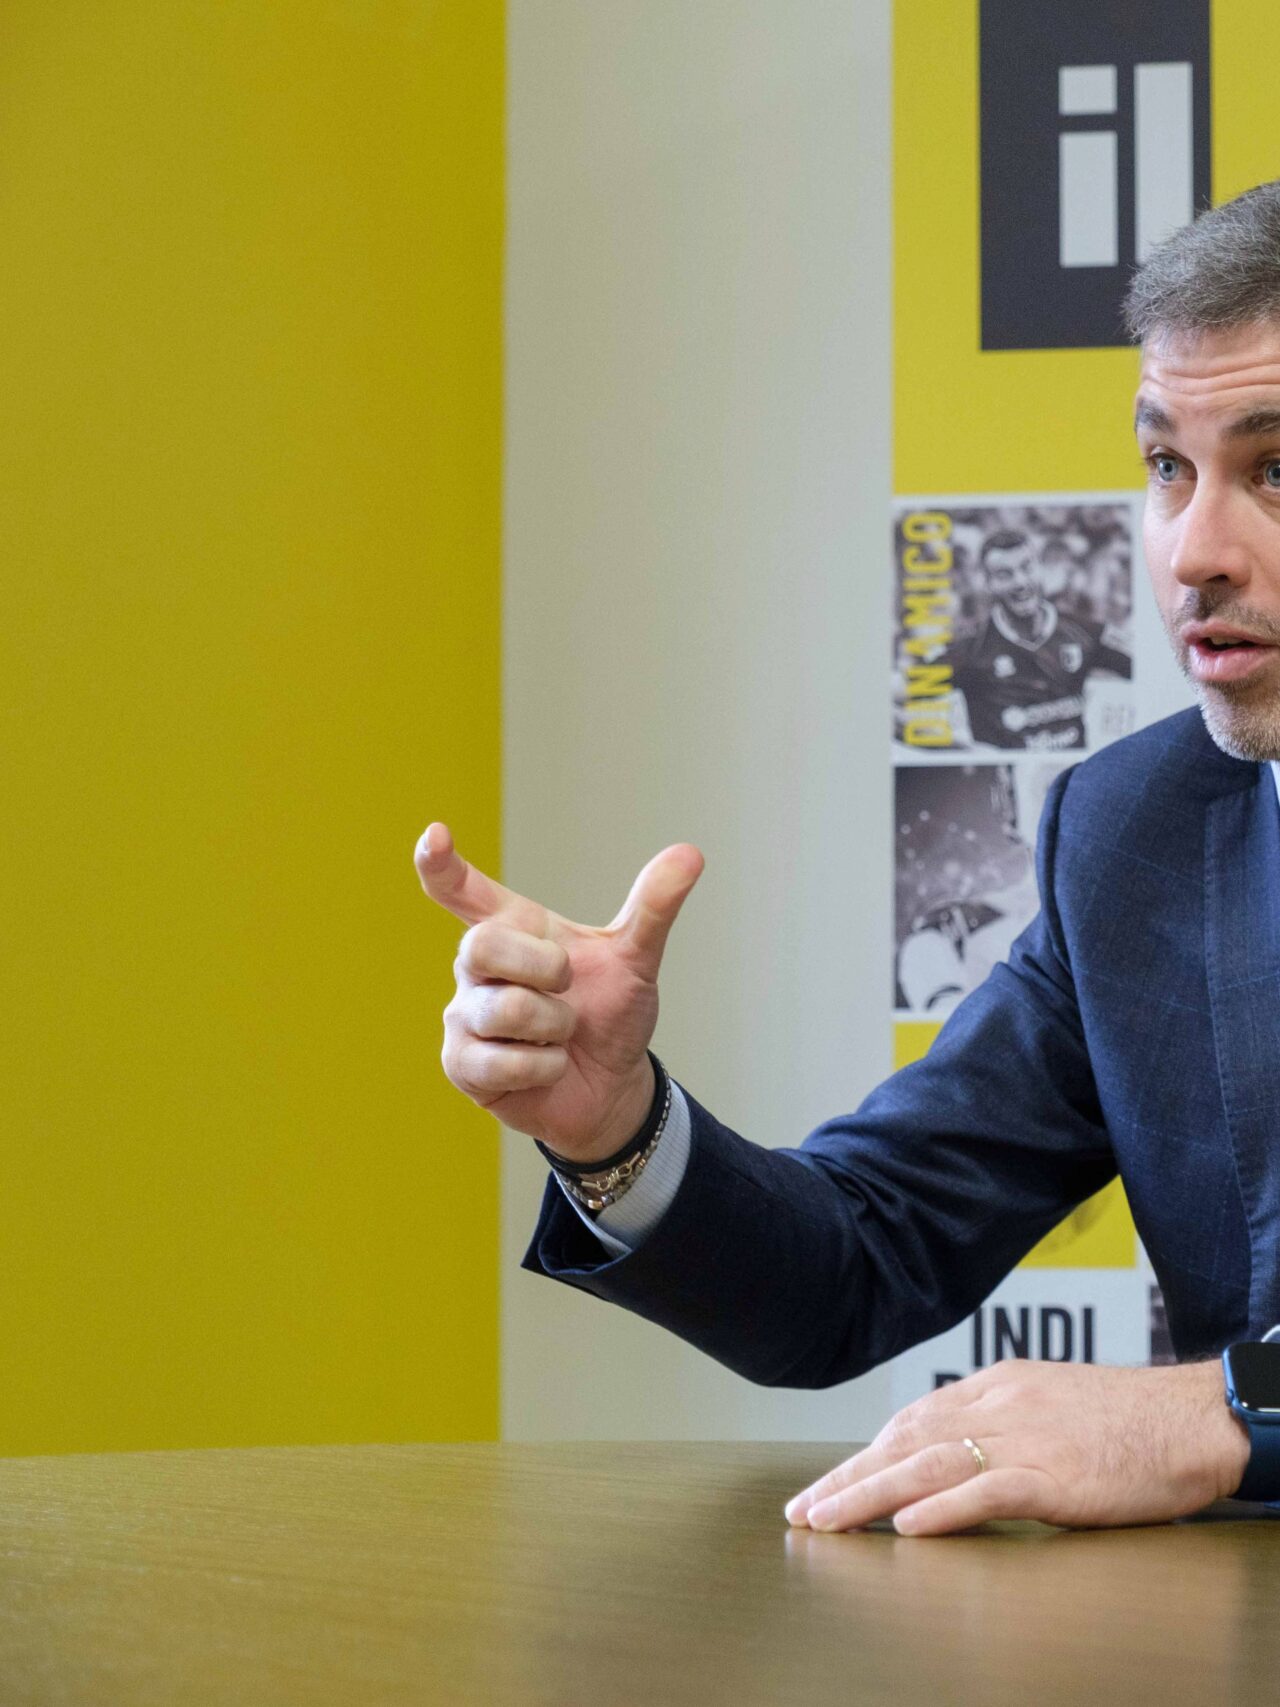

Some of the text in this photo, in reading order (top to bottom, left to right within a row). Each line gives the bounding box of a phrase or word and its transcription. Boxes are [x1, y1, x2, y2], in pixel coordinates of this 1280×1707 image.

[1059, 63, 1194, 267] il
[903, 511, 954, 747] DINAMICO
[973, 1306, 1095, 1367] INDI
